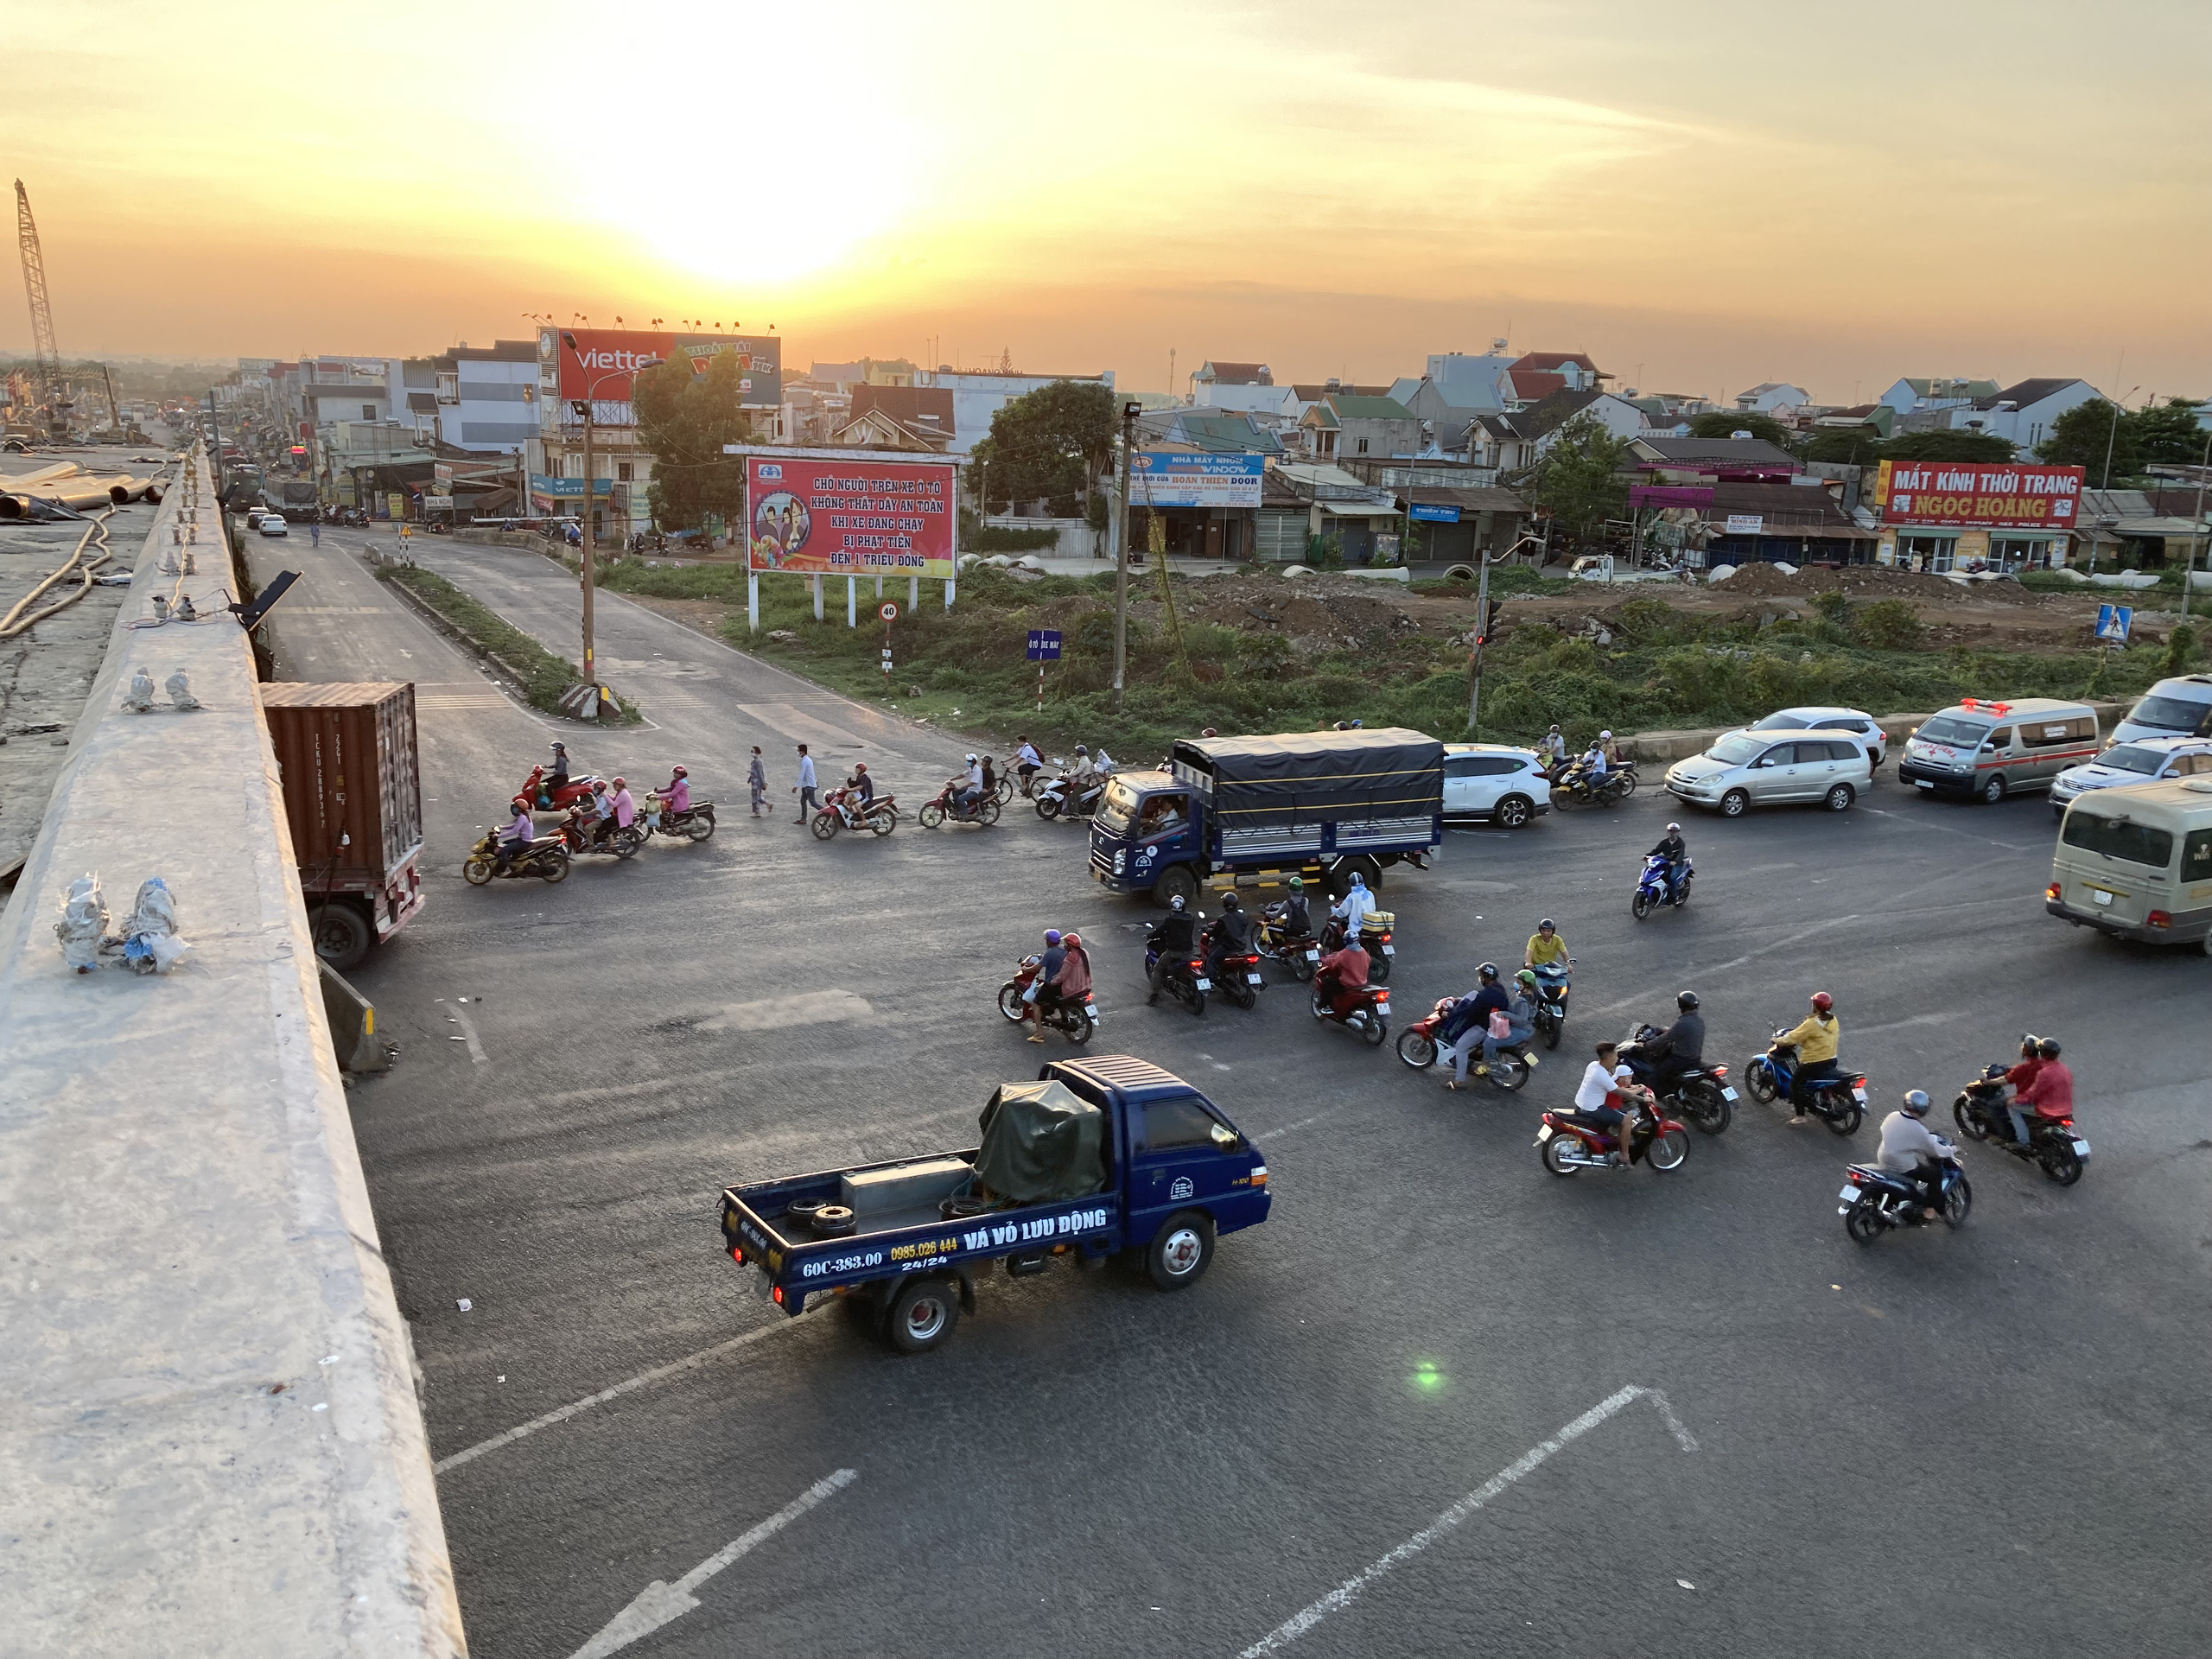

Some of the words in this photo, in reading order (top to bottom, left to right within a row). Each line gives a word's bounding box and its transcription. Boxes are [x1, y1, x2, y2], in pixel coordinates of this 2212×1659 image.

[576, 348, 657, 370] viettel
[814, 474, 836, 490] CHỞ
[837, 476, 868, 492] NGƯỜI
[870, 478, 899, 493] TRÊN
[901, 480, 915, 493] XE
[918, 479, 925, 494] Ô
[1894, 464, 1931, 490] MẮT
[1936, 467, 1976, 492] KÍNH
[1980, 469, 2020, 493] THỜI
[2024, 474, 2078, 494] TRANG
[810, 494, 845, 509] KHÔNG
[878, 496, 899, 512] DÂY
[899, 499, 915, 512] AN
[917, 498, 944, 513] TOÀN
[1914, 495, 1974, 518] NGỌC
[1974, 493, 2048, 518] HOÀNG
[830, 516, 849, 529] KHI
[851, 517, 865, 529] XE
[868, 517, 895, 530] ĐANG
[898, 518, 925, 533] CHẠY
[843, 535, 855, 550] BỊ
[857, 535, 884, 550] PHẠT
[830, 549, 851, 565] ĐẾN
[855, 554, 860, 565] 1
[863, 551, 894, 568] TRIỆU
[963, 1226, 989, 1250] VÁ
[992, 1220, 1018, 1245] VỎ
[1022, 1218, 1055, 1240] LƯU
[1058, 1209, 1107, 1236] ĐỘNG
[891, 1241, 937, 1261] 0985.026
[939, 1237, 957, 1252] 444
[803, 1252, 883, 1277] 60C-383.00
[902, 1255, 948, 1271] 24/24
